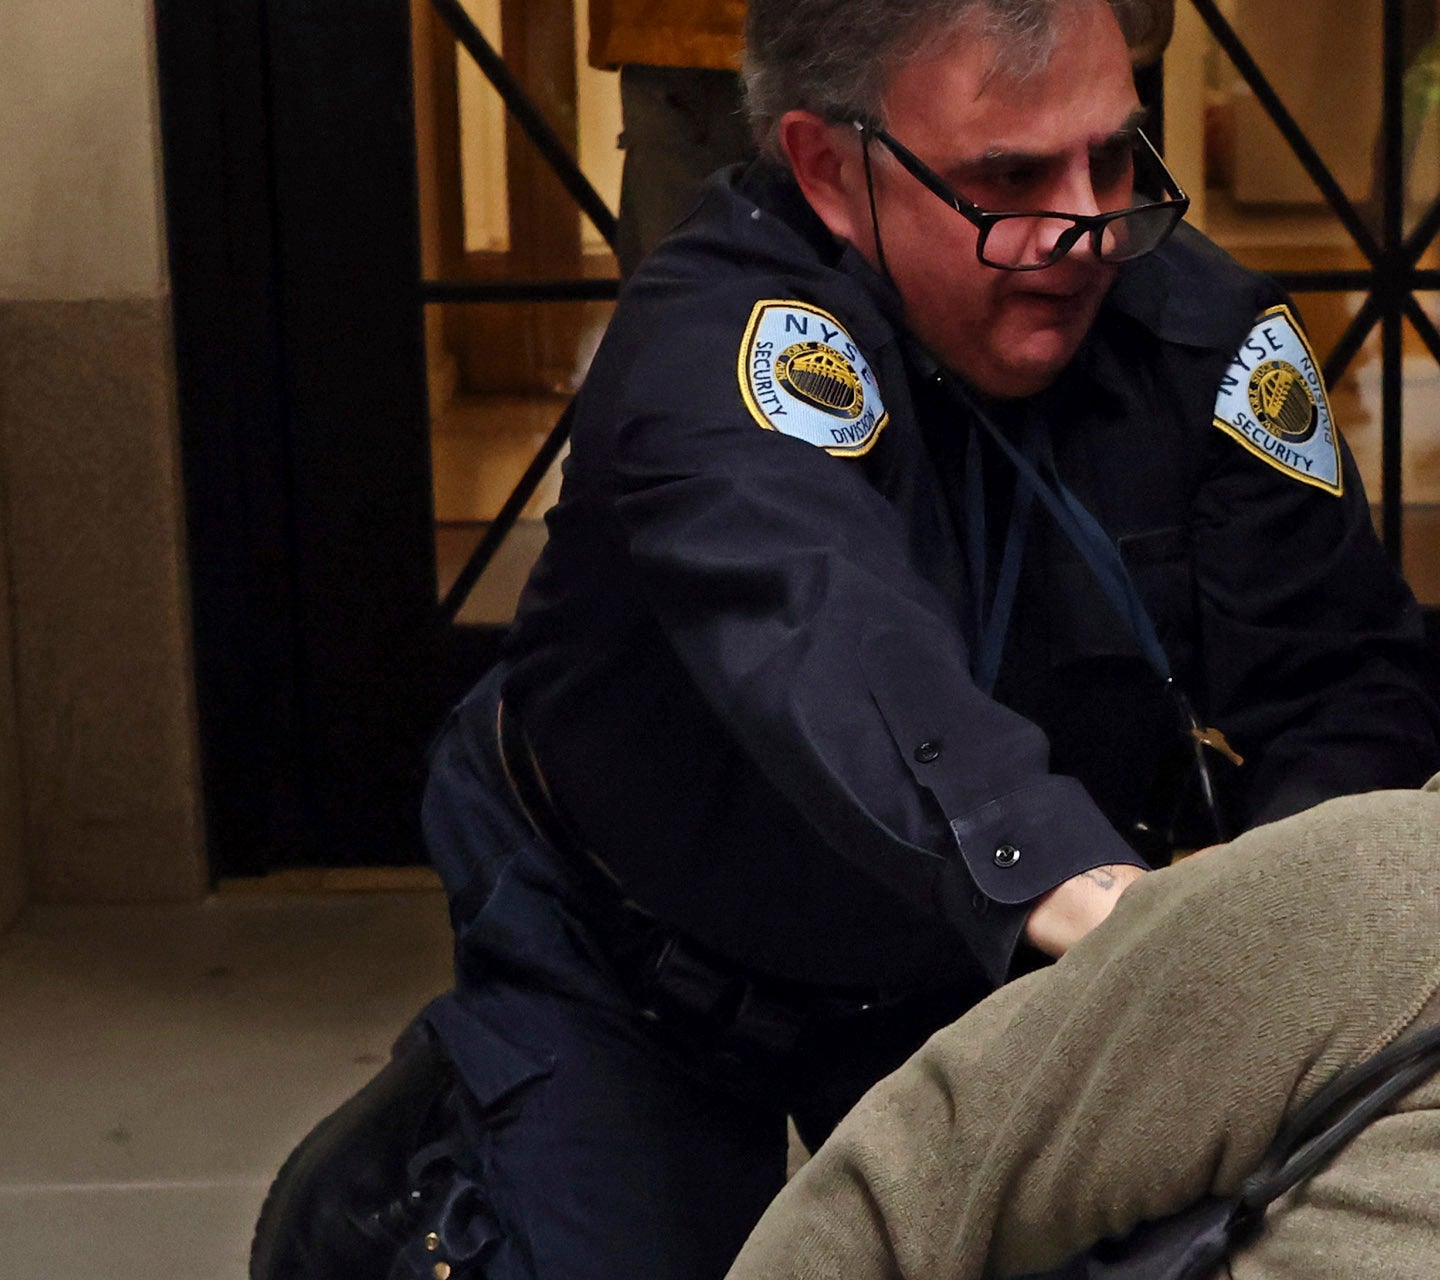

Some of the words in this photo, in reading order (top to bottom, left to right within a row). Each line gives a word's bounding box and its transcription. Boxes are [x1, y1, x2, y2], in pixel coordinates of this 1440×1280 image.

[754, 341, 788, 417] SECURITY
[830, 405, 877, 444] DIVISION
[785, 314, 872, 385] NYSE
[1218, 327, 1284, 397] NYSE
[1232, 412, 1313, 473] SECURITY
[1300, 357, 1334, 447] DIVISION
